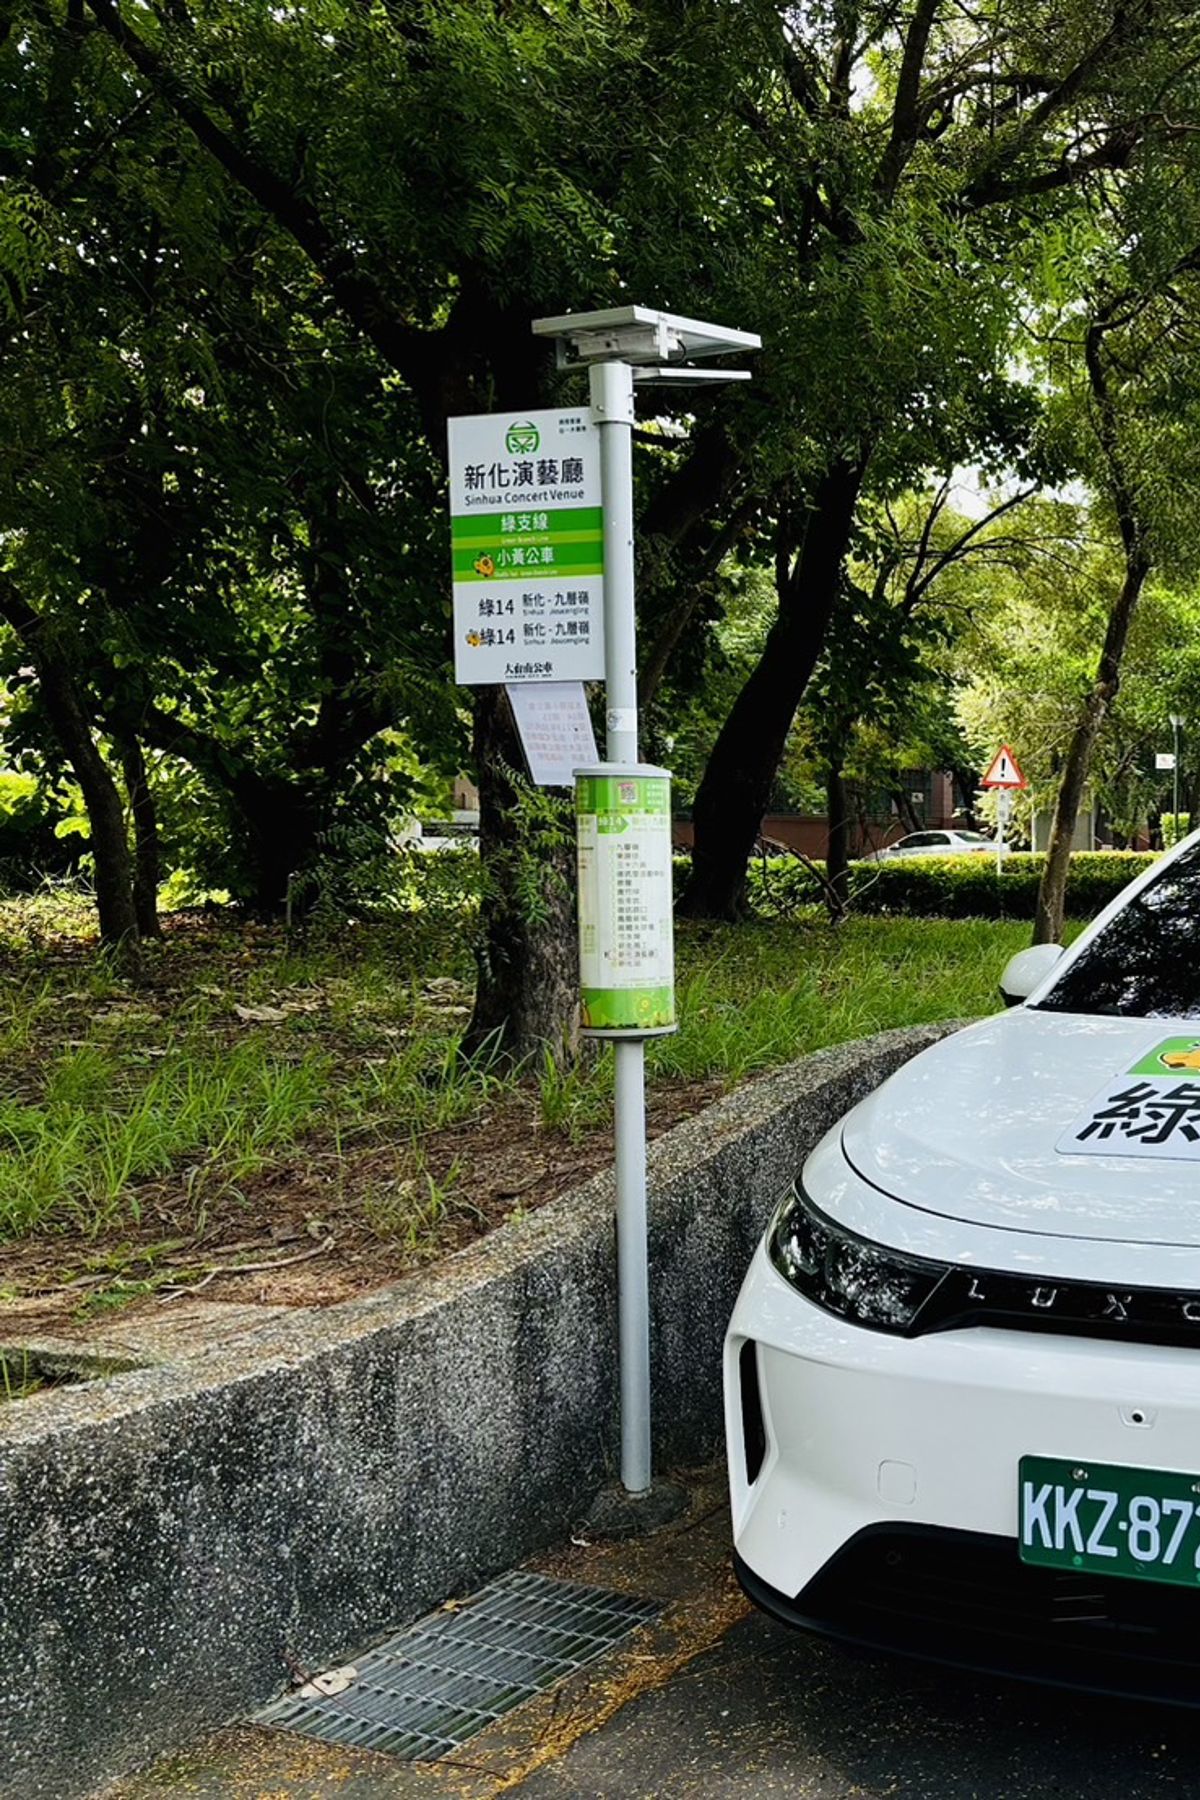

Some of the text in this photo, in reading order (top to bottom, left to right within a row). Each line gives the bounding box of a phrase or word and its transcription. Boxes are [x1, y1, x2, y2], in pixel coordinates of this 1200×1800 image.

[464, 457, 584, 490] 新化演藝廳
[465, 488, 585, 506] Sinhua Concert Venue
[501, 512, 549, 532] 綠支線
[497, 546, 554, 567] 小黃公車
[478, 598, 514, 617] 綠14
[479, 628, 515, 647] 綠14
